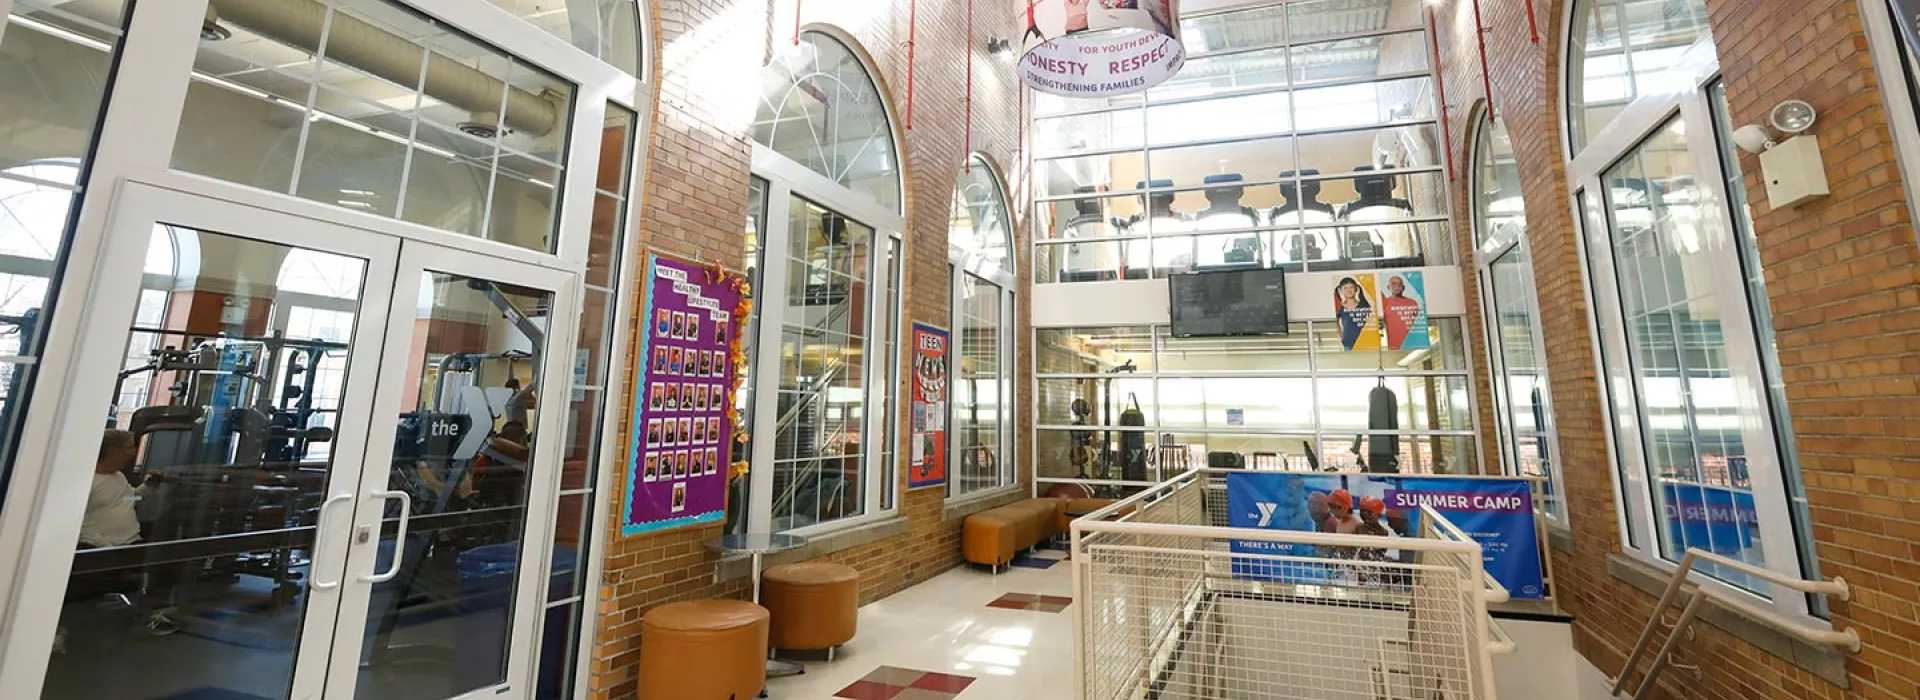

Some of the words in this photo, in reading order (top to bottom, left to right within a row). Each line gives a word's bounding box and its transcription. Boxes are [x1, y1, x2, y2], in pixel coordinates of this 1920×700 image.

[1078, 45, 1099, 55] FOR
[1101, 40, 1137, 54] YOUTH
[1109, 38, 1169, 75] RESPECT
[1027, 70, 1098, 92] STRENGTHENING
[1100, 75, 1146, 92] FAMILIES
[712, 310, 728, 319] TEAM
[921, 334, 943, 350] TEEN
[431, 419, 459, 436] the
[1395, 493, 1469, 509] SUMMER
[1473, 496, 1521, 510] CAMP
[1238, 541, 1269, 550] THERE'S
[1270, 542, 1277, 550] A
[1277, 543, 1294, 551] WAY
